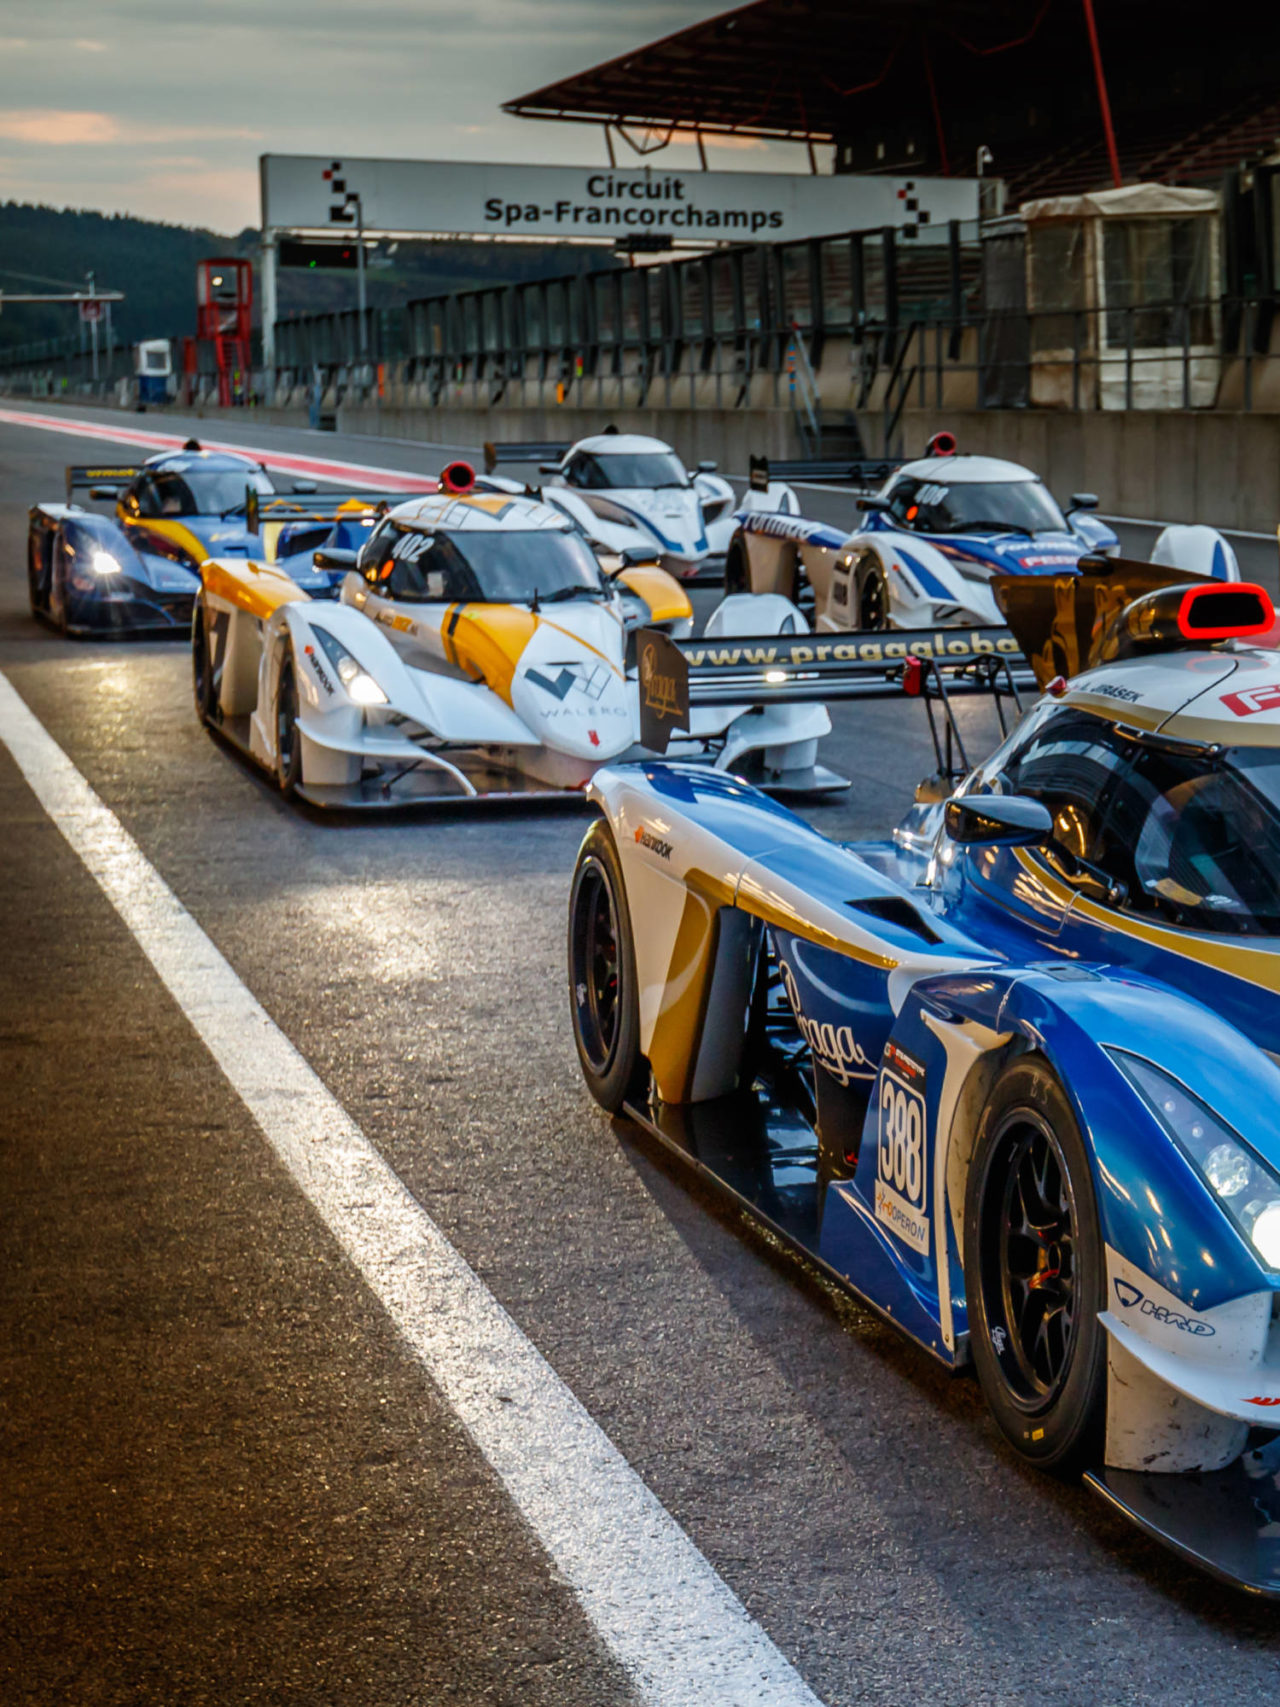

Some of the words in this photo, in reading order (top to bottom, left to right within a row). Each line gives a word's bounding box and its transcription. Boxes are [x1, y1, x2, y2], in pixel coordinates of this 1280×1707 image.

[586, 175, 685, 201] Circuit
[484, 198, 784, 233] Spa-Francorchamps
[392, 533, 436, 563] 402
[881, 1080, 921, 1202] 388
